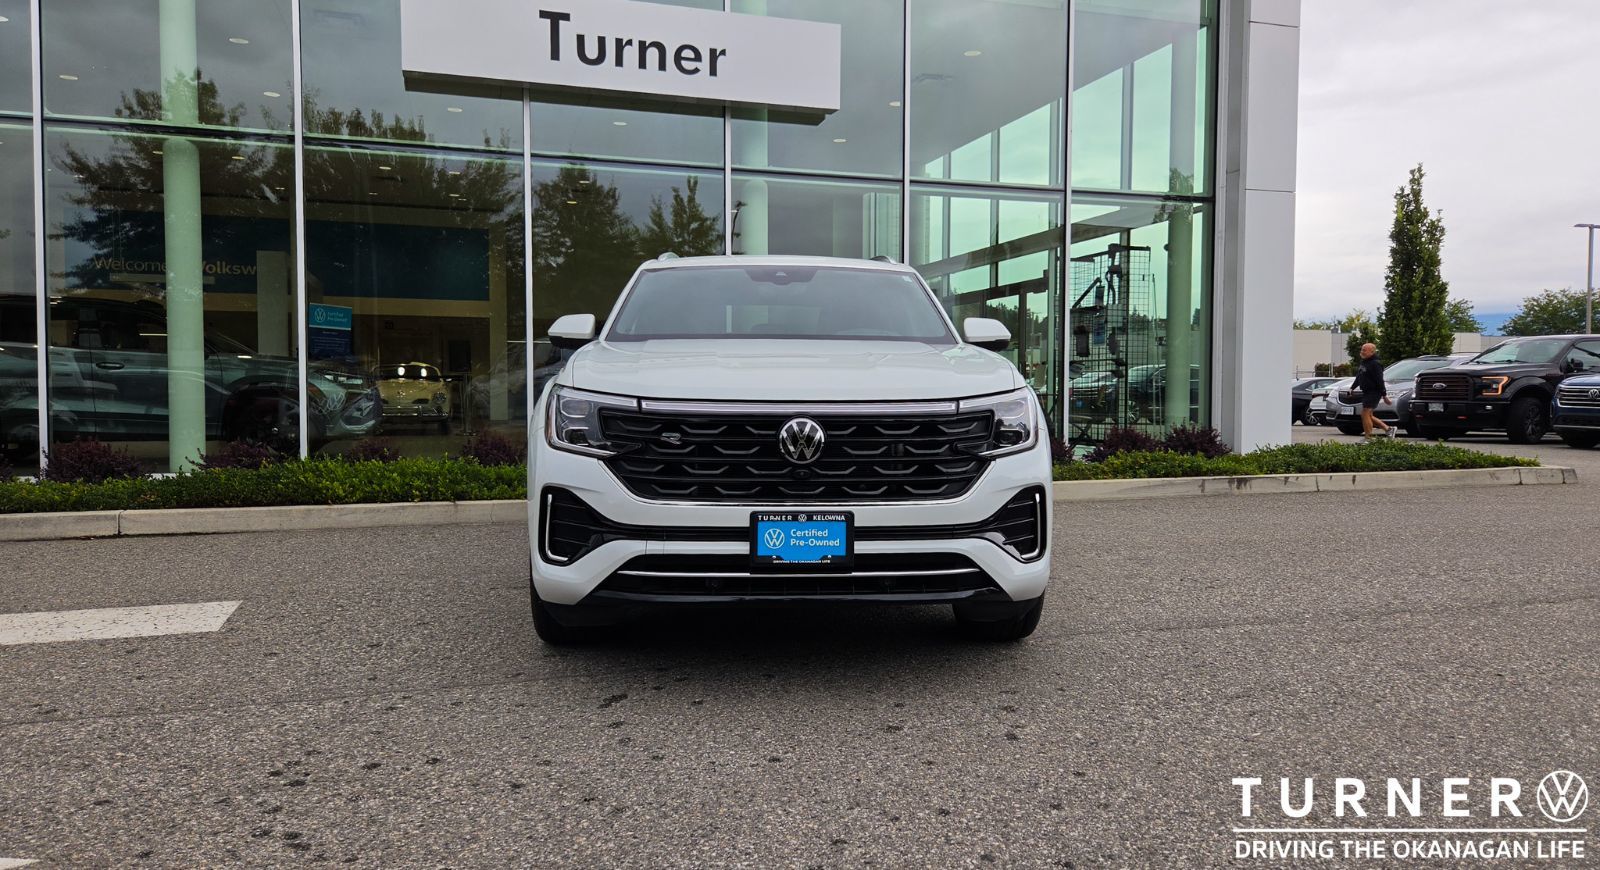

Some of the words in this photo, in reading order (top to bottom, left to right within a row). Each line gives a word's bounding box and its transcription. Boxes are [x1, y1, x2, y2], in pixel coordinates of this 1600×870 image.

[538, 9, 727, 77] Turner
[790, 528, 829, 537] Certified
[790, 538, 840, 547] Pre-Owned
